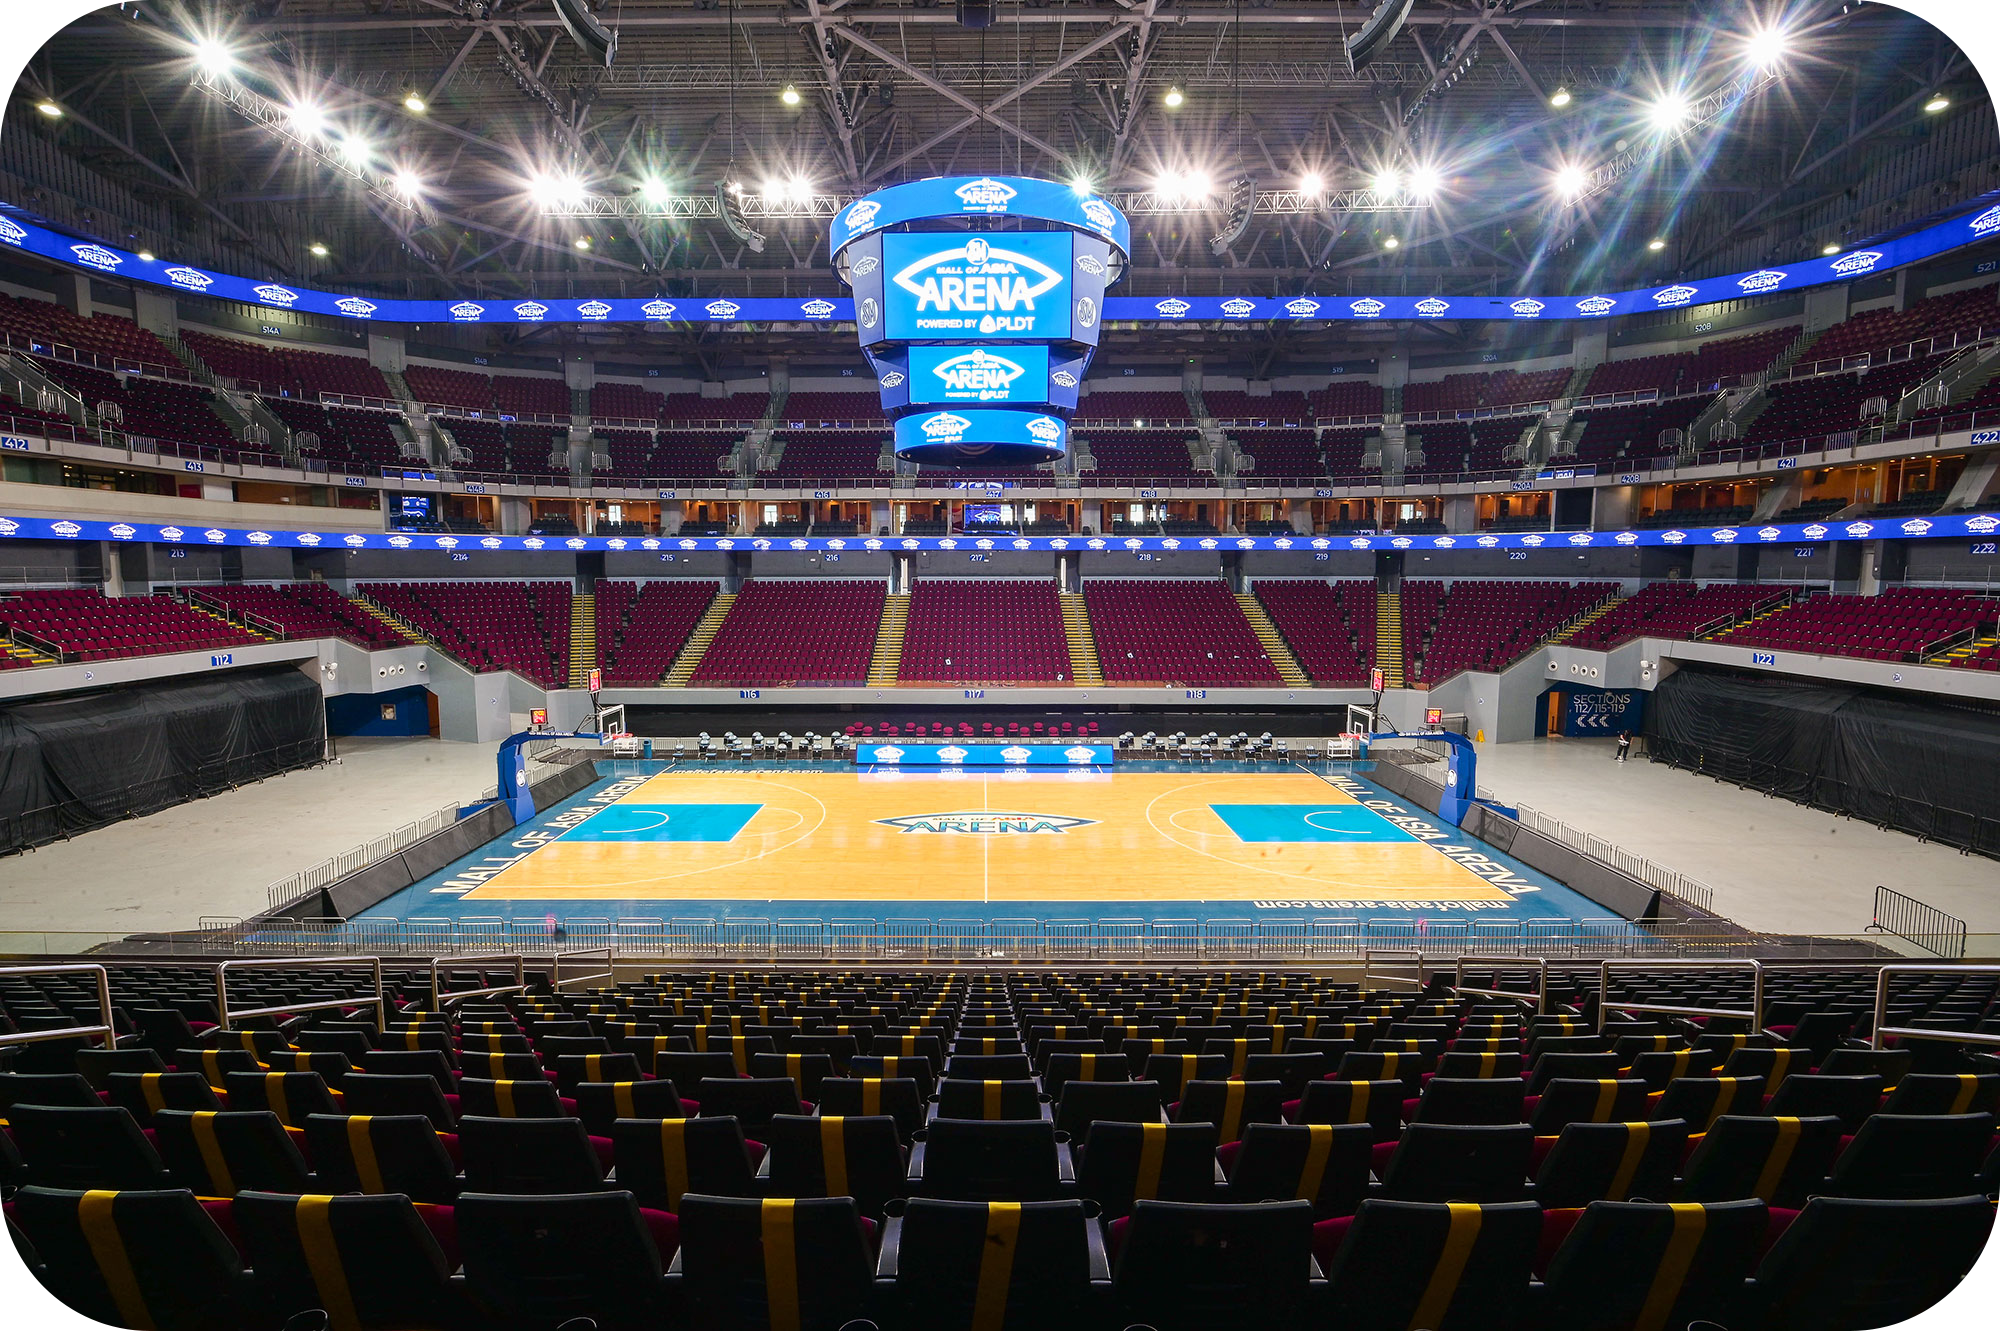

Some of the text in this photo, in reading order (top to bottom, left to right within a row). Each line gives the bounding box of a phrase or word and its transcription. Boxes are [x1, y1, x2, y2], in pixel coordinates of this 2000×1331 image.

[963, 191, 1008, 204] ARENA
[78, 249, 116, 267] ARENA
[979, 263, 1019, 274] ASIA
[1837, 258, 1875, 273] ARENA
[1977, 261, 1996, 273] 521
[172, 272, 206, 288] ARENA
[1743, 276, 1779, 290] ARENA
[260, 290, 293, 304] ARENA
[917, 277, 1035, 311] ARENA
[1658, 291, 1690, 304] ARENA
[917, 317, 1035, 330] POWERED BY PLDT
[1695, 322, 1712, 333] 520B
[262, 325, 280, 335] 514A
[474, 357, 488, 365] 514B
[945, 370, 1010, 389] ARENA
[927, 423, 962, 437] ARENA
[1972, 431, 1998, 444] 422
[5, 438, 26, 450] 412
[187, 461, 202, 471] 413
[1780, 458, 1794, 468] 421
[346, 477, 364, 486] 414A
[1621, 474, 1640, 484] 420B
[468, 485, 484, 493] 414B
[1513, 481, 1531, 490] 420A
[171, 549, 185, 558] 213
[1797, 547, 1811, 557] 221
[1972, 543, 1996, 554] 222
[453, 553, 468, 561] 214
[1316, 553, 1329, 561] 219
[1510, 552, 1527, 560] 220
[214, 654, 229, 666] 112
[1756, 653, 1772, 665] 122
[743, 690, 757, 698] 116
[968, 690, 981, 698] 117
[1190, 690, 1203, 698] 118
[1573, 694, 1631, 704] SECTIONS
[1574, 703, 1626, 713] 112/115-119
[902, 821, 1064, 833] ARENA
[429, 775, 654, 894] MALL OF ASIA ARENA
[1320, 775, 1542, 895] MALL OF ASIA ARENA
[1252, 899, 1512, 912] mallofasia-arena.com
